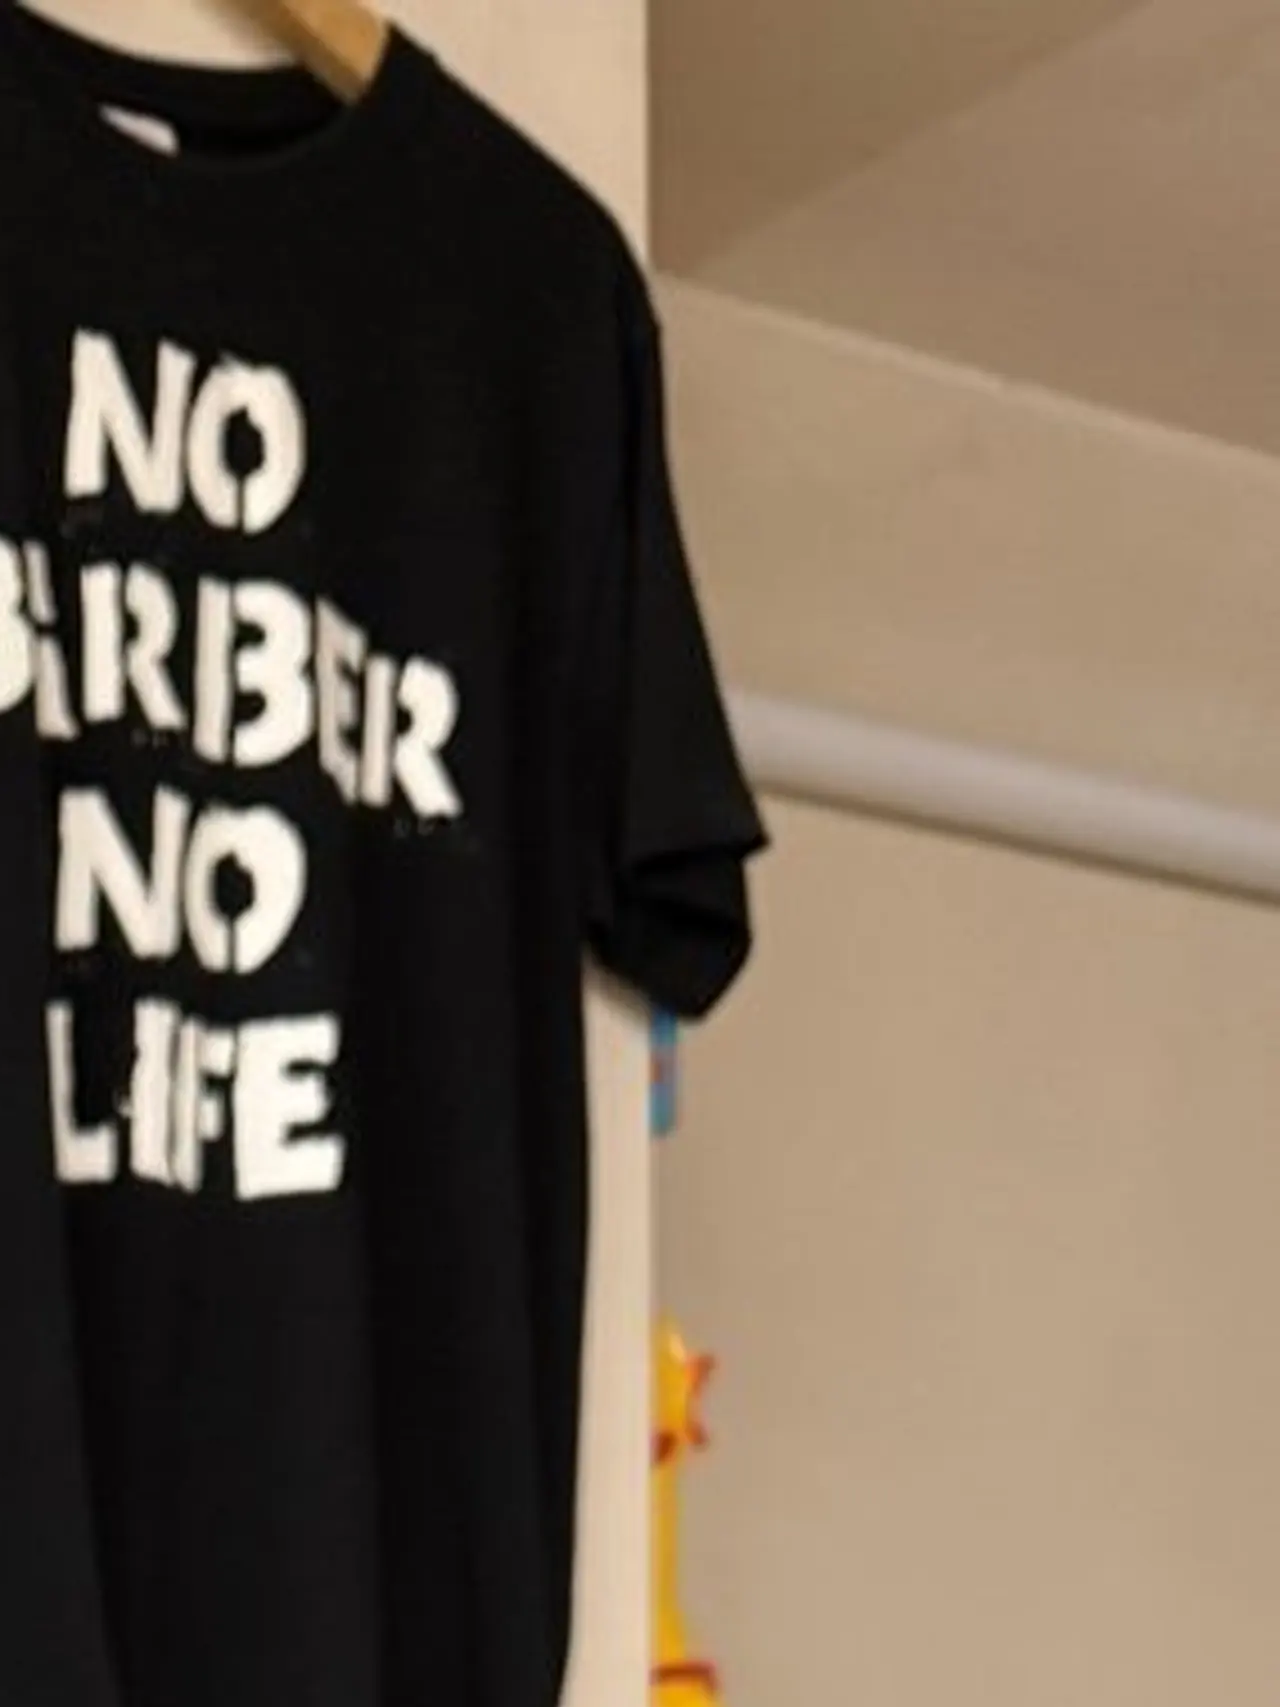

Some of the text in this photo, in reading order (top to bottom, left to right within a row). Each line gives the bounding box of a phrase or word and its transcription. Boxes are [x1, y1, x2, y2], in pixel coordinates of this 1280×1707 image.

[65, 326, 306, 534] NO
[55, 784, 306, 974] NO
[46, 999, 344, 1200] LIFE
